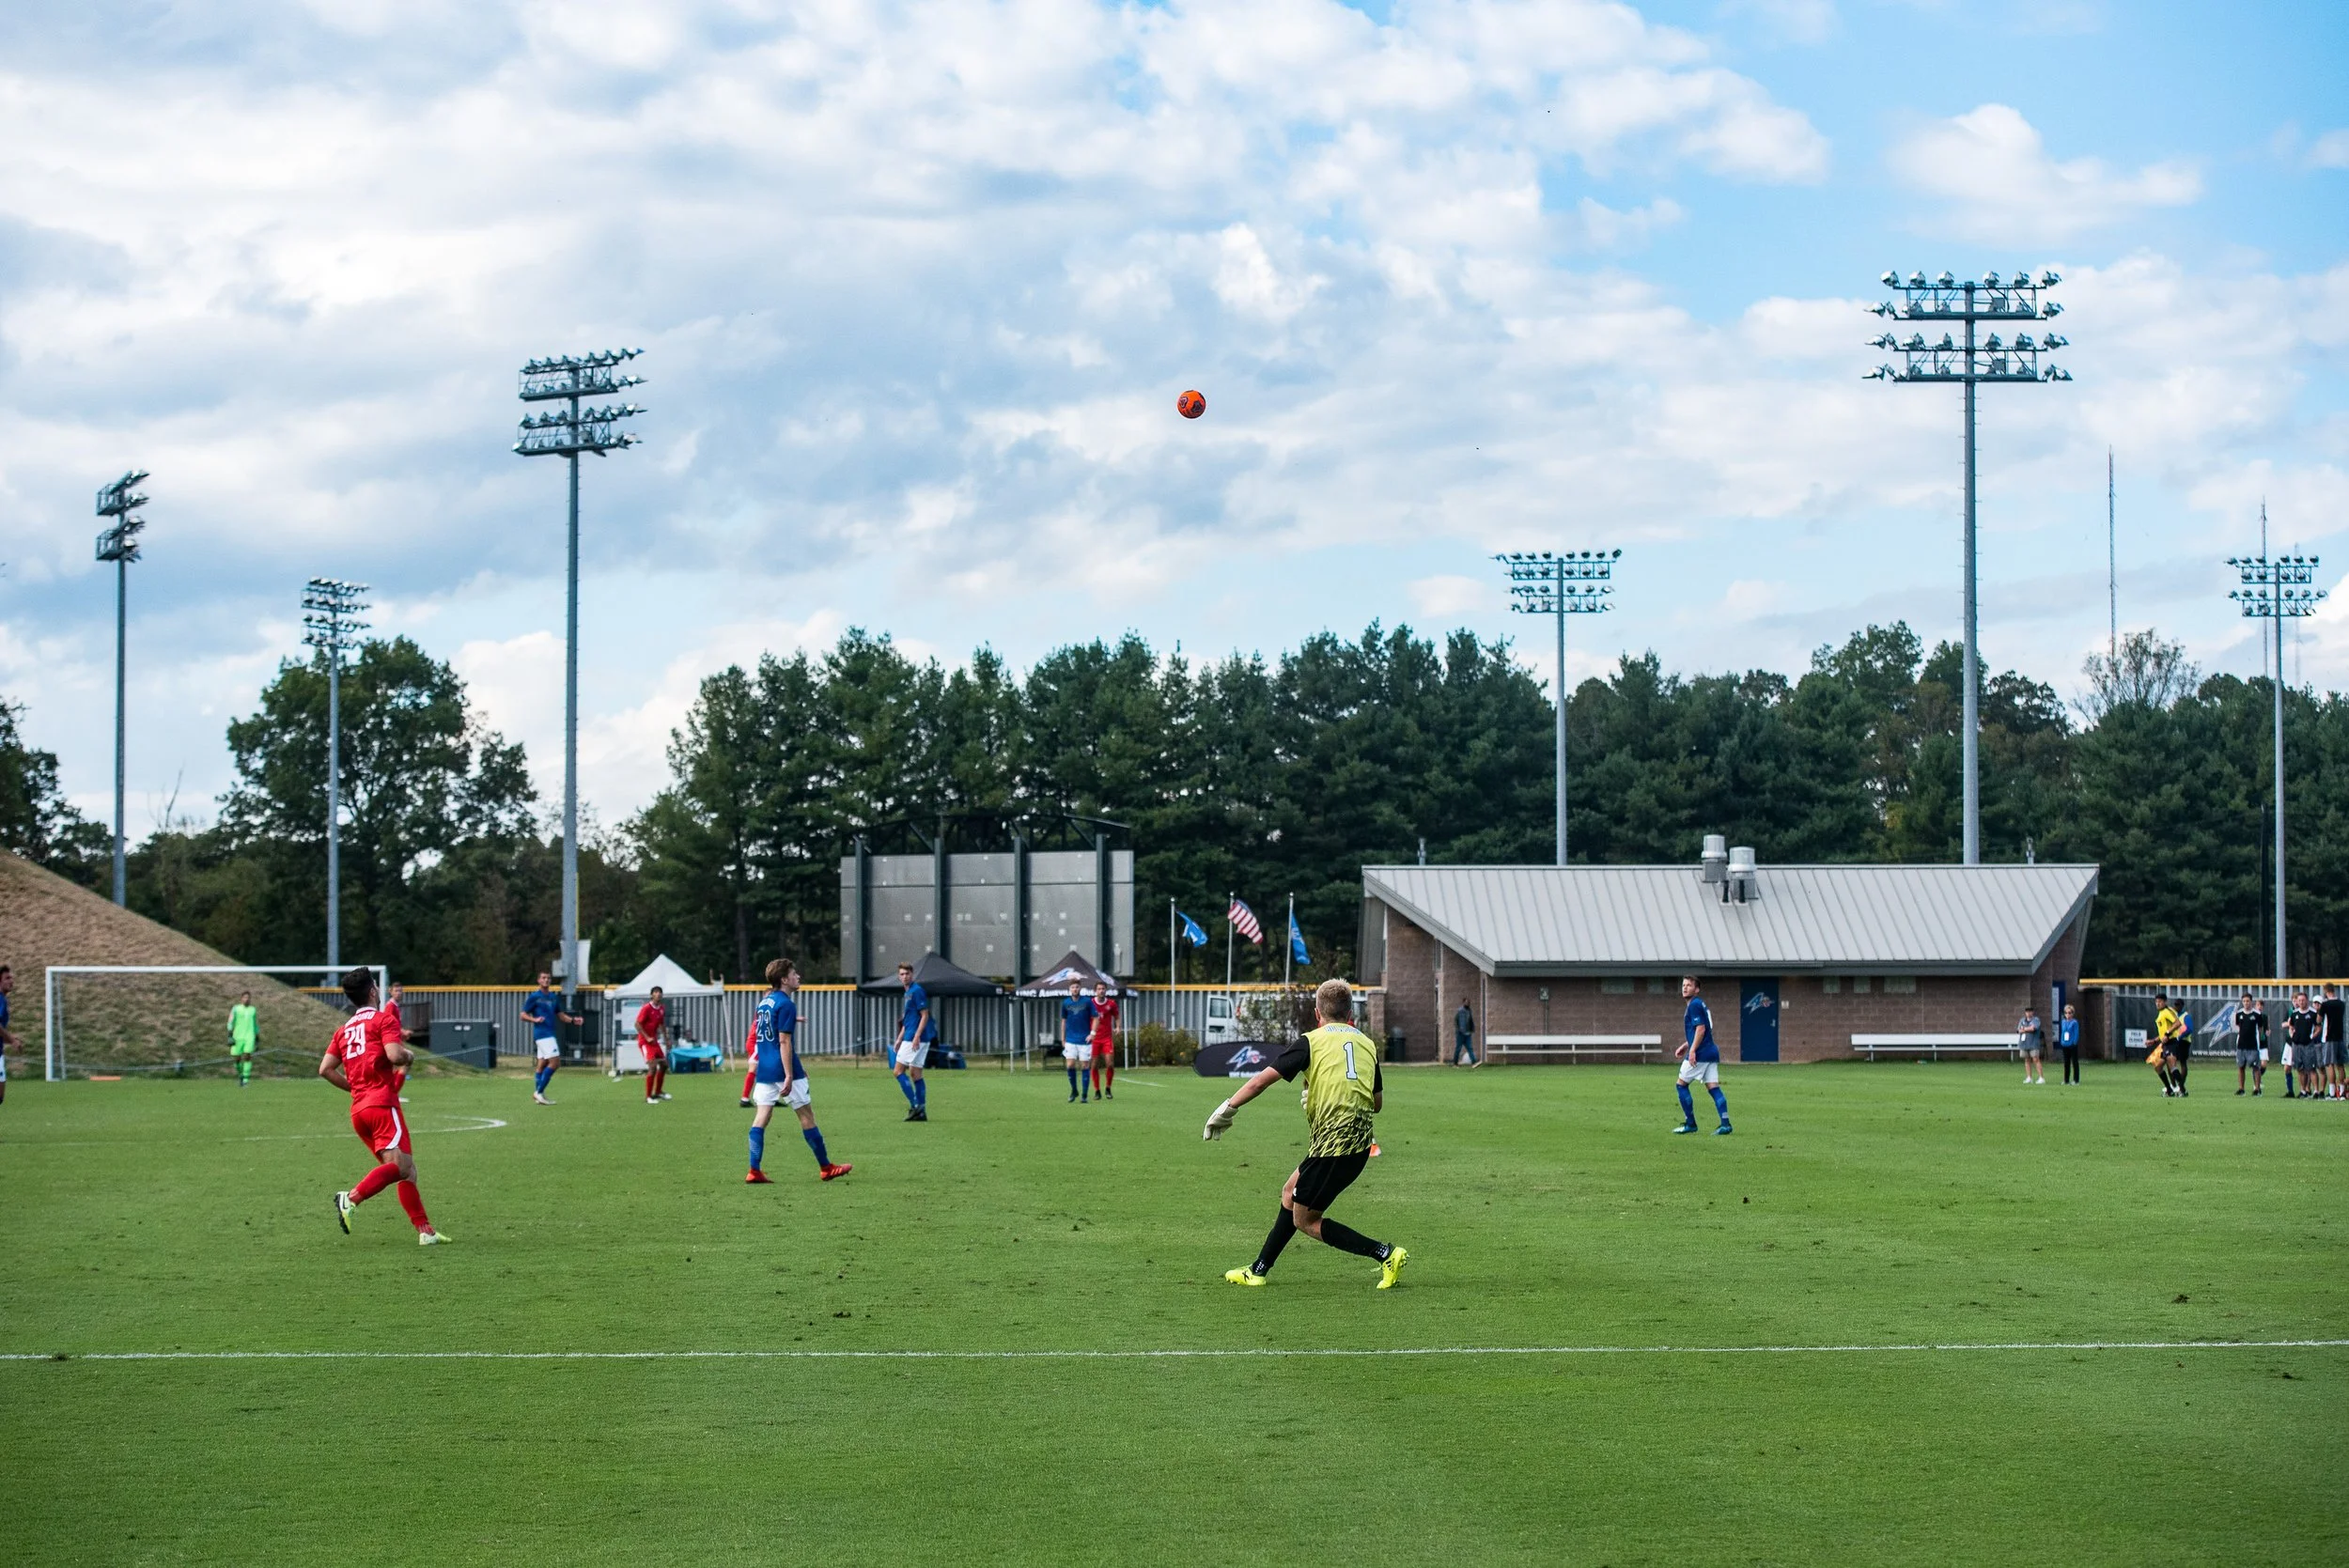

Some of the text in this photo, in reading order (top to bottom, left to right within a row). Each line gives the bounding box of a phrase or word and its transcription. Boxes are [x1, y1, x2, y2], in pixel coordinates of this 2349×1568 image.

[344, 1022, 366, 1060] 29
[756, 1009, 775, 1042] 23
[1343, 1041, 1359, 1080] 1
